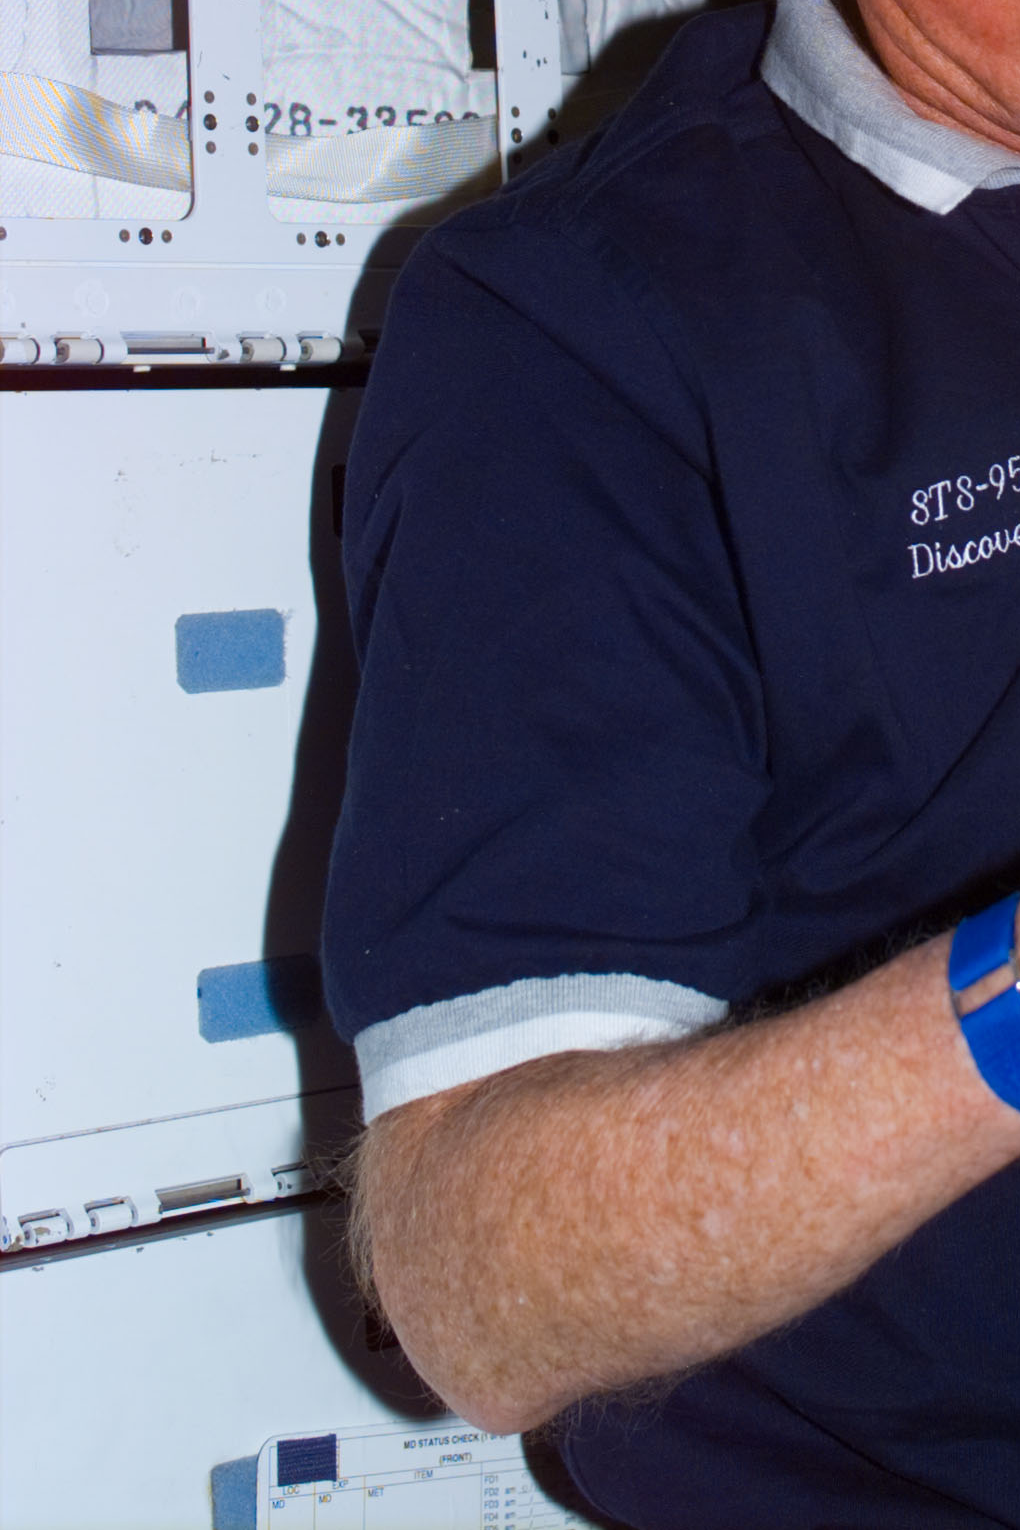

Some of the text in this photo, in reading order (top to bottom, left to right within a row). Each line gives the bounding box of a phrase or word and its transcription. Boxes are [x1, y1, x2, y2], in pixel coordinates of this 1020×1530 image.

[403, 1440, 417, 1450] MD
[418, 1436, 450, 1448] STATUS
[451, 1433, 480, 1445] CHECK
[439, 1452, 472, 1467] (FRONT)
[414, 1470, 434, 1480] ITEM
[484, 1475, 499, 1484] FD1
[332, 1479, 349, 1490] EXP
[282, 1485, 300, 1496] LOC
[367, 1486, 384, 1498] MET
[484, 1488, 500, 1497] FD2
[319, 1494, 332, 1504] MD
[272, 1500, 286, 1510] MD
[484, 1500, 500, 1509] FD3
[484, 1512, 500, 1521] FD4
